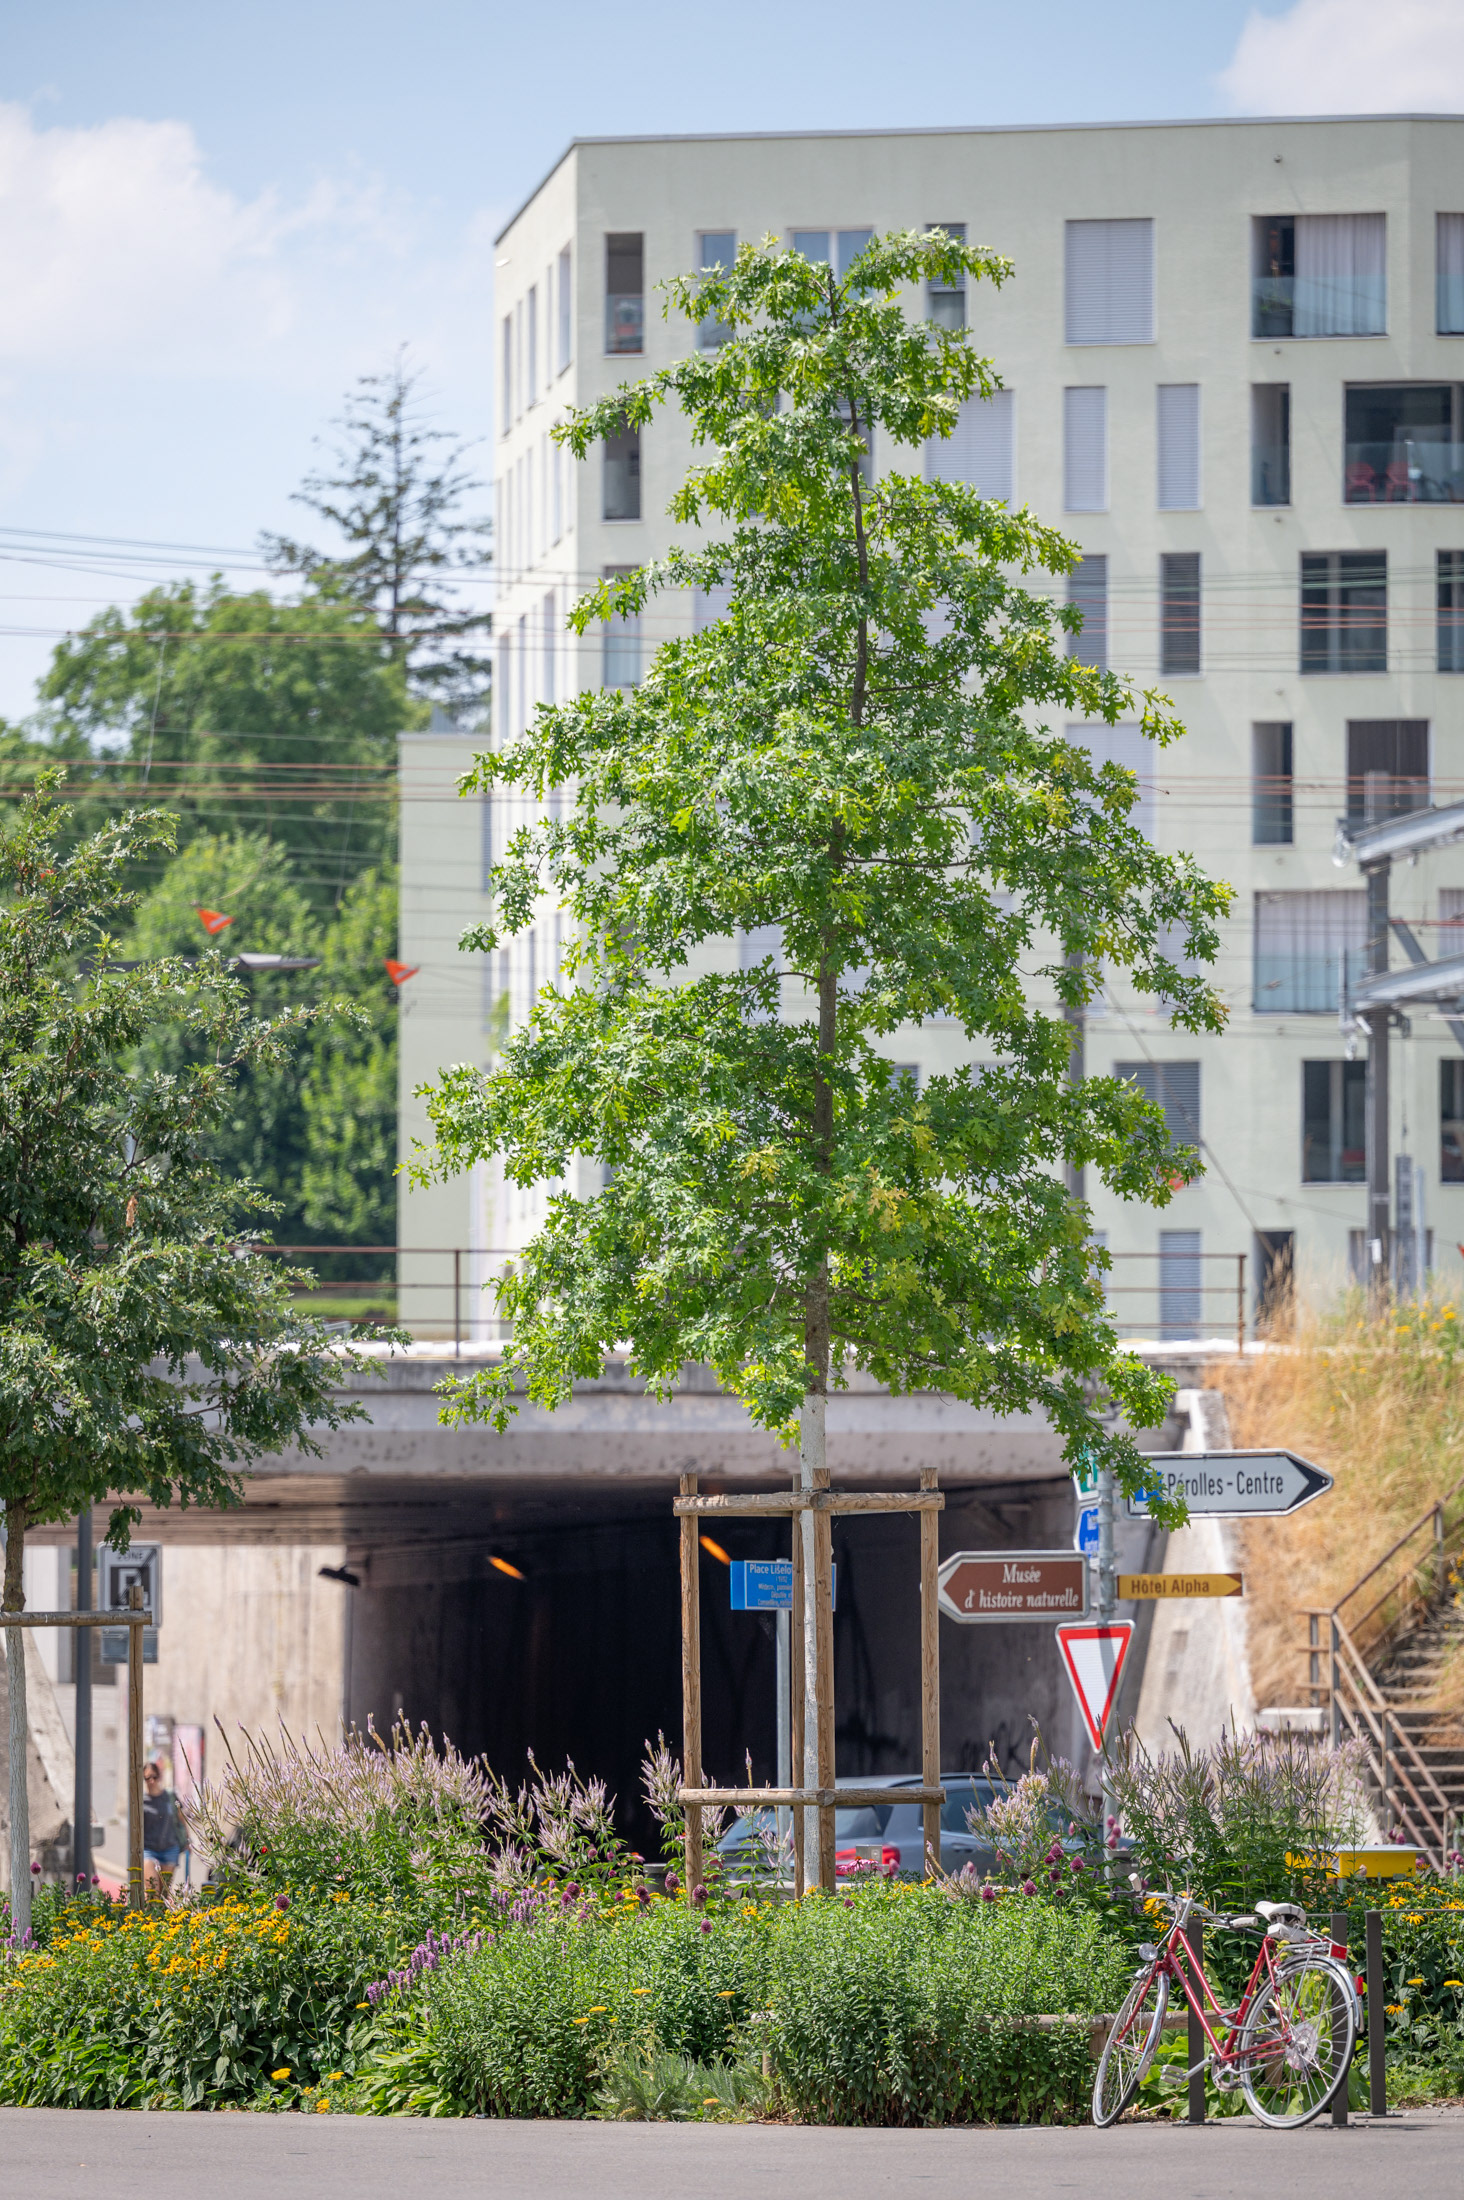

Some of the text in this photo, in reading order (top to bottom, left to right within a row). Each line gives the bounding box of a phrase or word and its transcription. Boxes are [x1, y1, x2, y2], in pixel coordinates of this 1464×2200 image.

[750, 1563, 769, 1574] Place
[1002, 1563, 1042, 1584] Musée
[1026, 1586, 1080, 1608] naturelle
[1131, 1579, 1210, 1596] Hôtel Alpha
